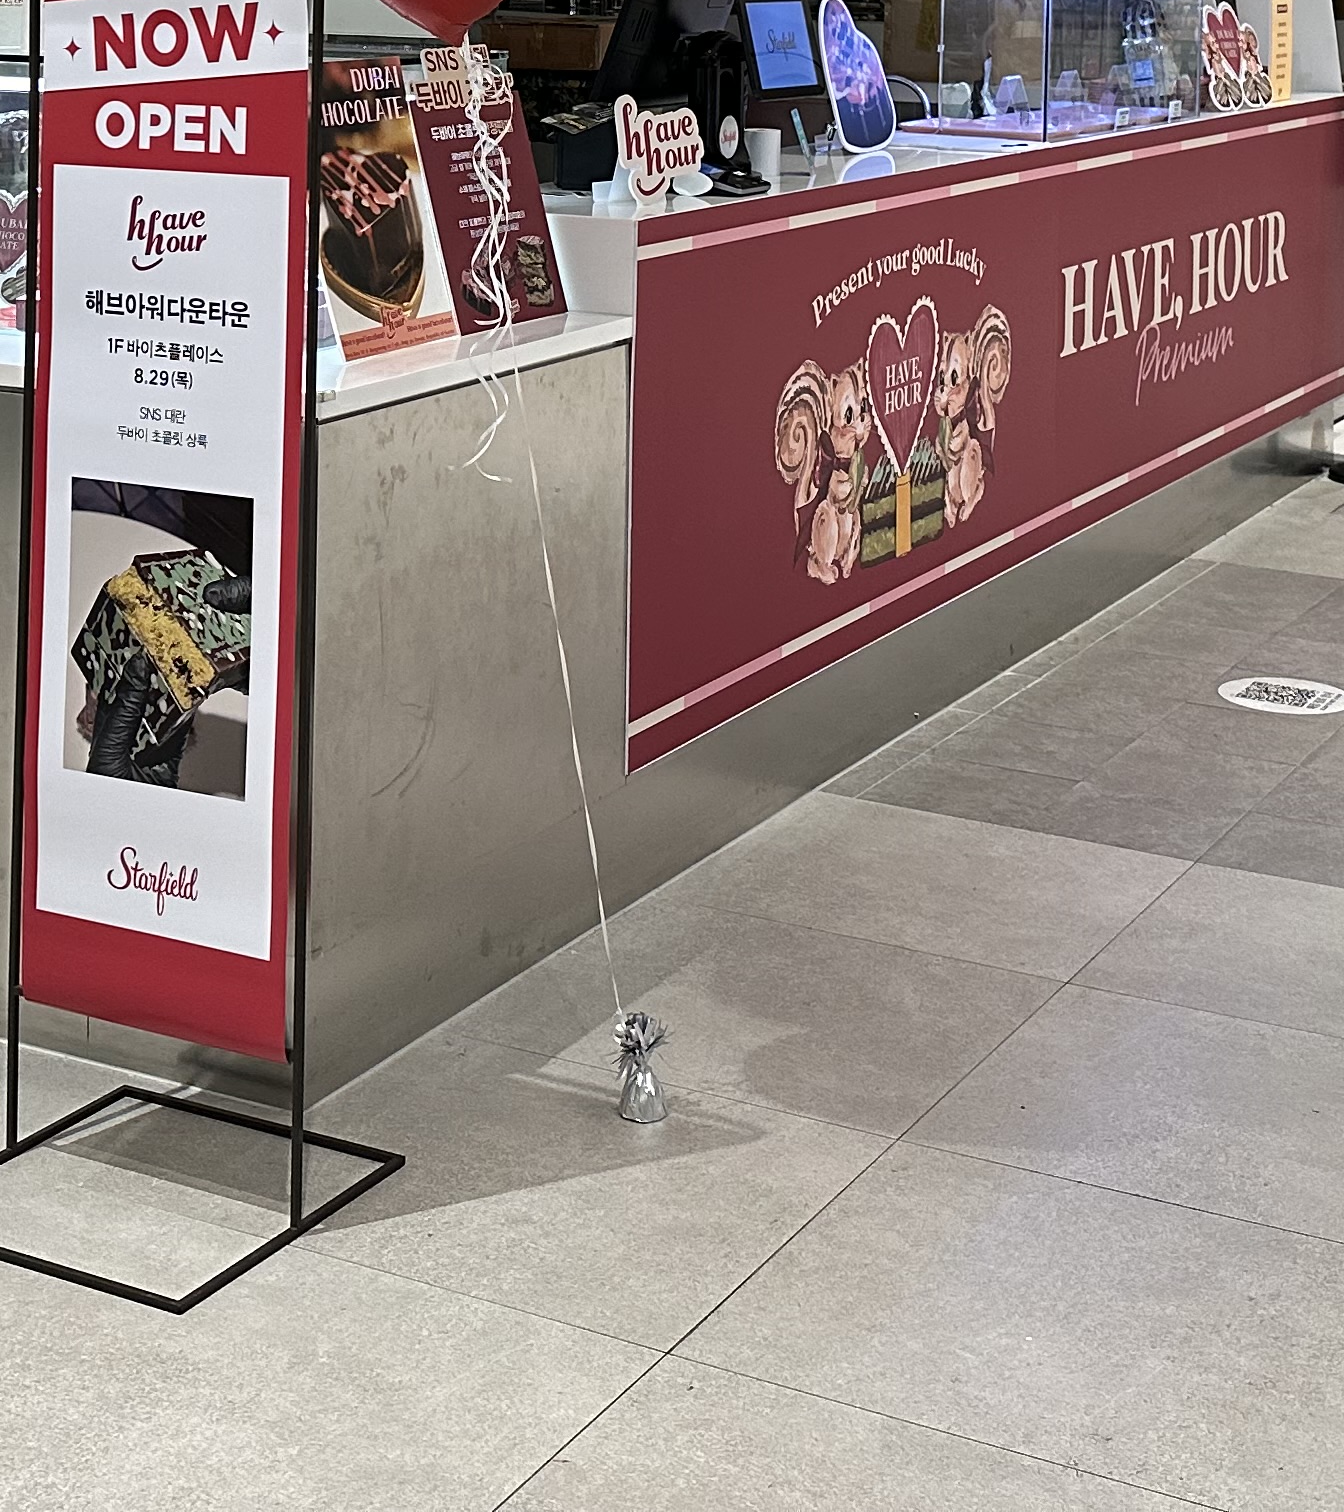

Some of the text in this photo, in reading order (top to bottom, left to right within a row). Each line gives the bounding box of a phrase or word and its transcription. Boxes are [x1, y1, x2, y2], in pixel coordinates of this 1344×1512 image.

[92, 2, 259, 72] NOW
[425, 49, 459, 72] SNS
[350, 65, 400, 93] DUBAI
[95, 100, 247, 155] OPEN
[321, 96, 405, 127] HOCOLATE
[811, 238, 987, 328] Present your good Lucky
[1060, 210, 1289, 358] HAVE, HOUR
[85, 289, 250, 329] 해브아워다운타운
[107, 337, 224, 365] 1F 바이츠플레이스
[1134, 324, 1235, 406] Premium
[134, 368, 193, 390] 8.29(목)
[886, 356, 923, 388] HAVE,
[885, 381, 922, 416] HOUR
[139, 406, 186, 425] SNS 대란
[116, 425, 208, 450] 두바이 초콜릿 상륙
[107, 846, 199, 916] Starfield
